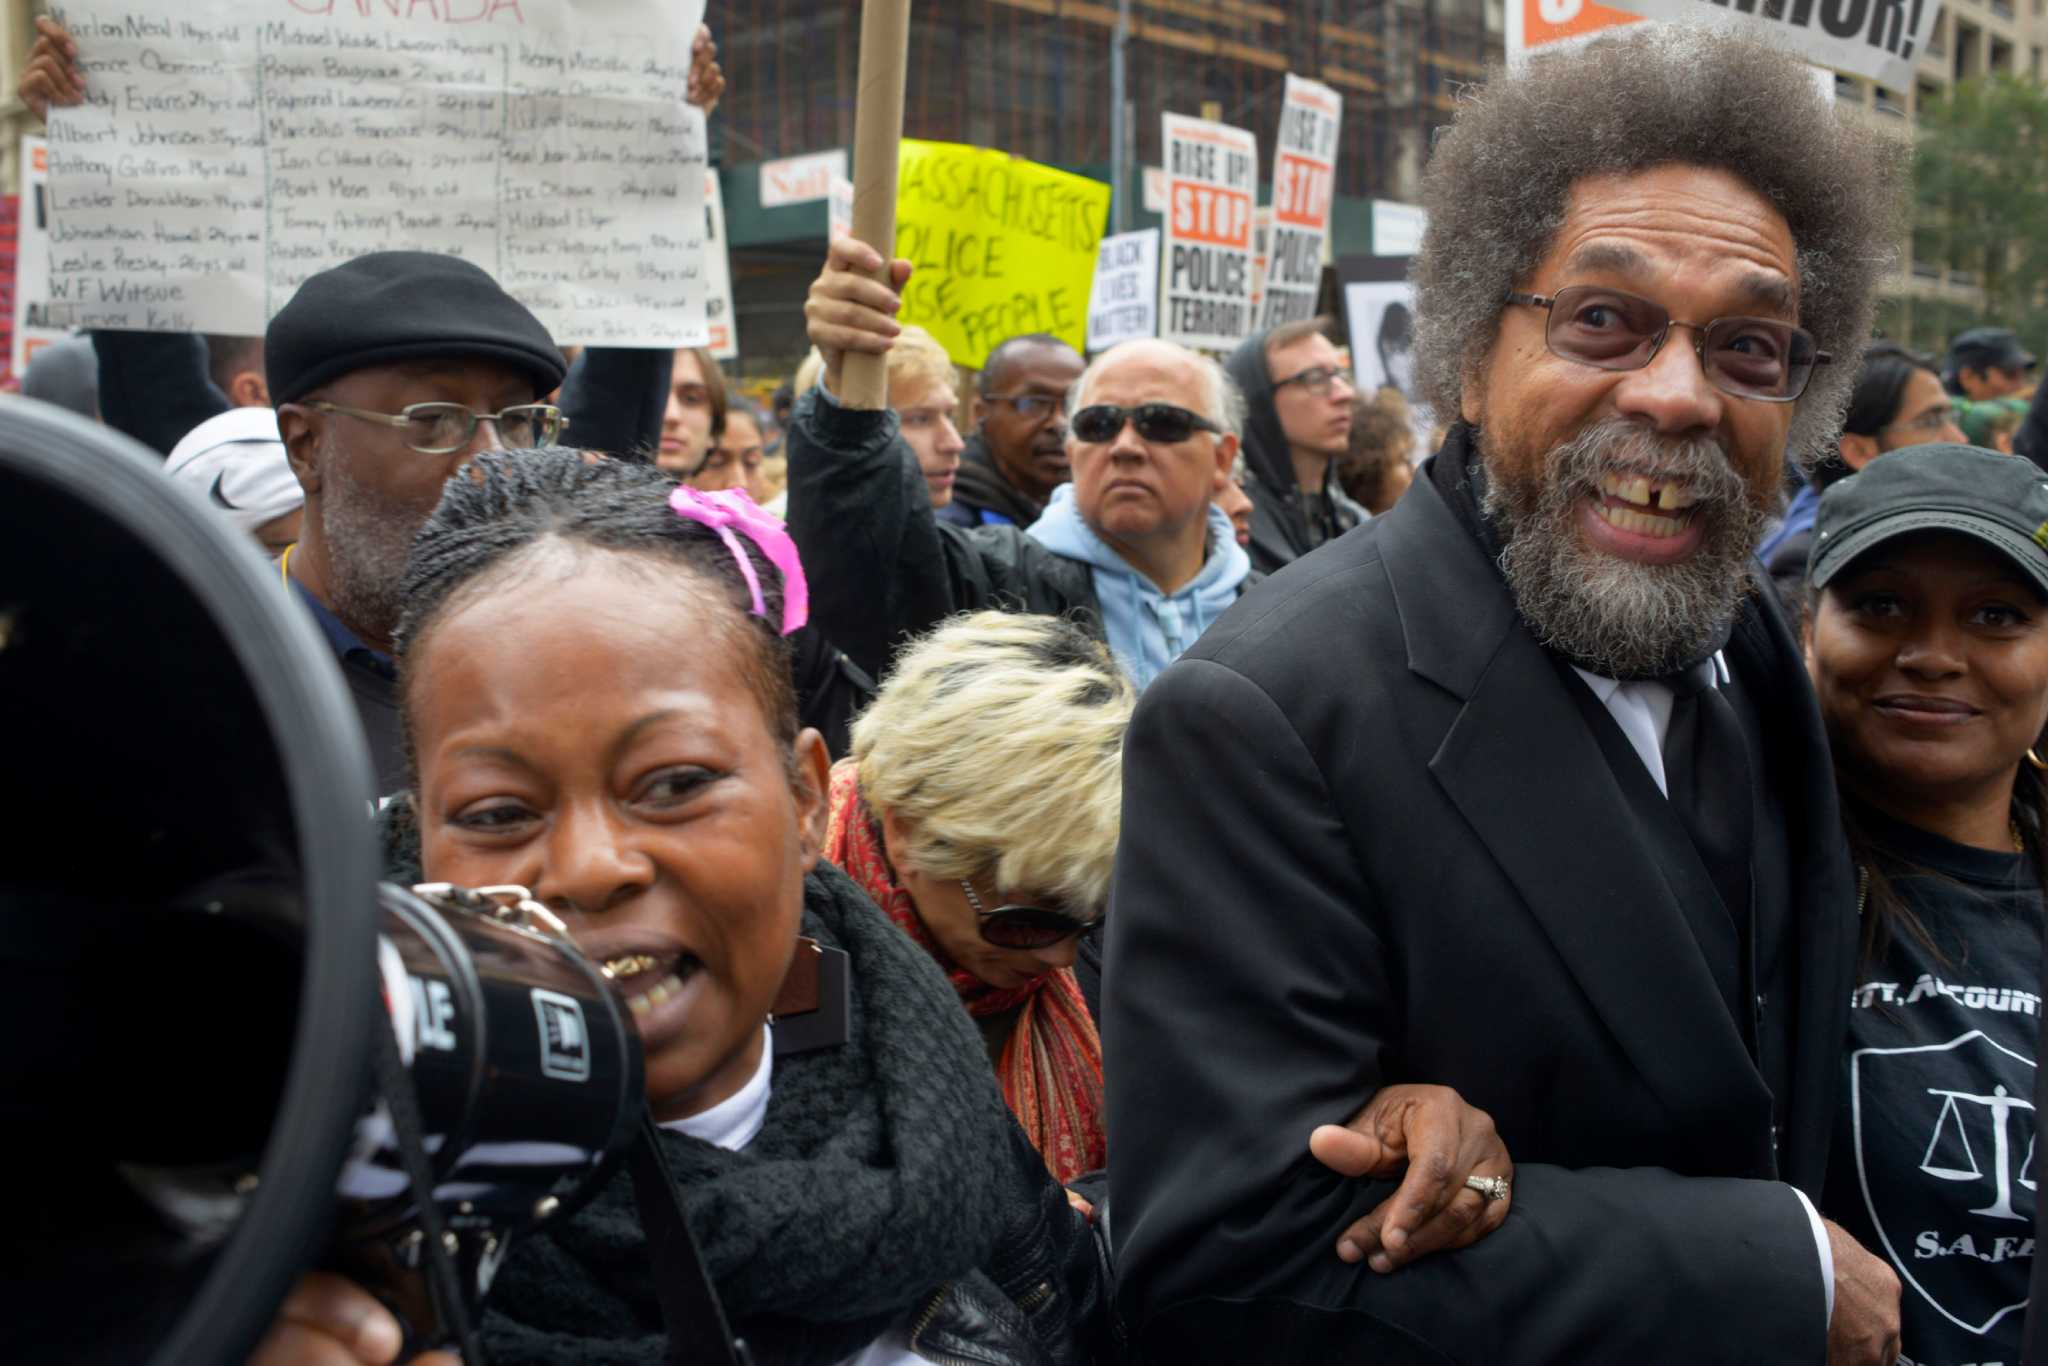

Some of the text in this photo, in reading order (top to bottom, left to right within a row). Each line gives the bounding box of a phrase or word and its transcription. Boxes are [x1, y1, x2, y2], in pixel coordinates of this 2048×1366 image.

[49, 119, 119, 144] Albert
[48, 151, 113, 187] Anthony
[271, 146, 312, 171] Ian
[1172, 140, 1216, 182] RISE
[50, 187, 116, 211] Lester
[1175, 187, 1247, 241] STOP
[898, 223, 1004, 278] OLICE
[1172, 245, 1248, 296] POLICE
[48, 278, 70, 300] W
[76, 278, 92, 300] F
